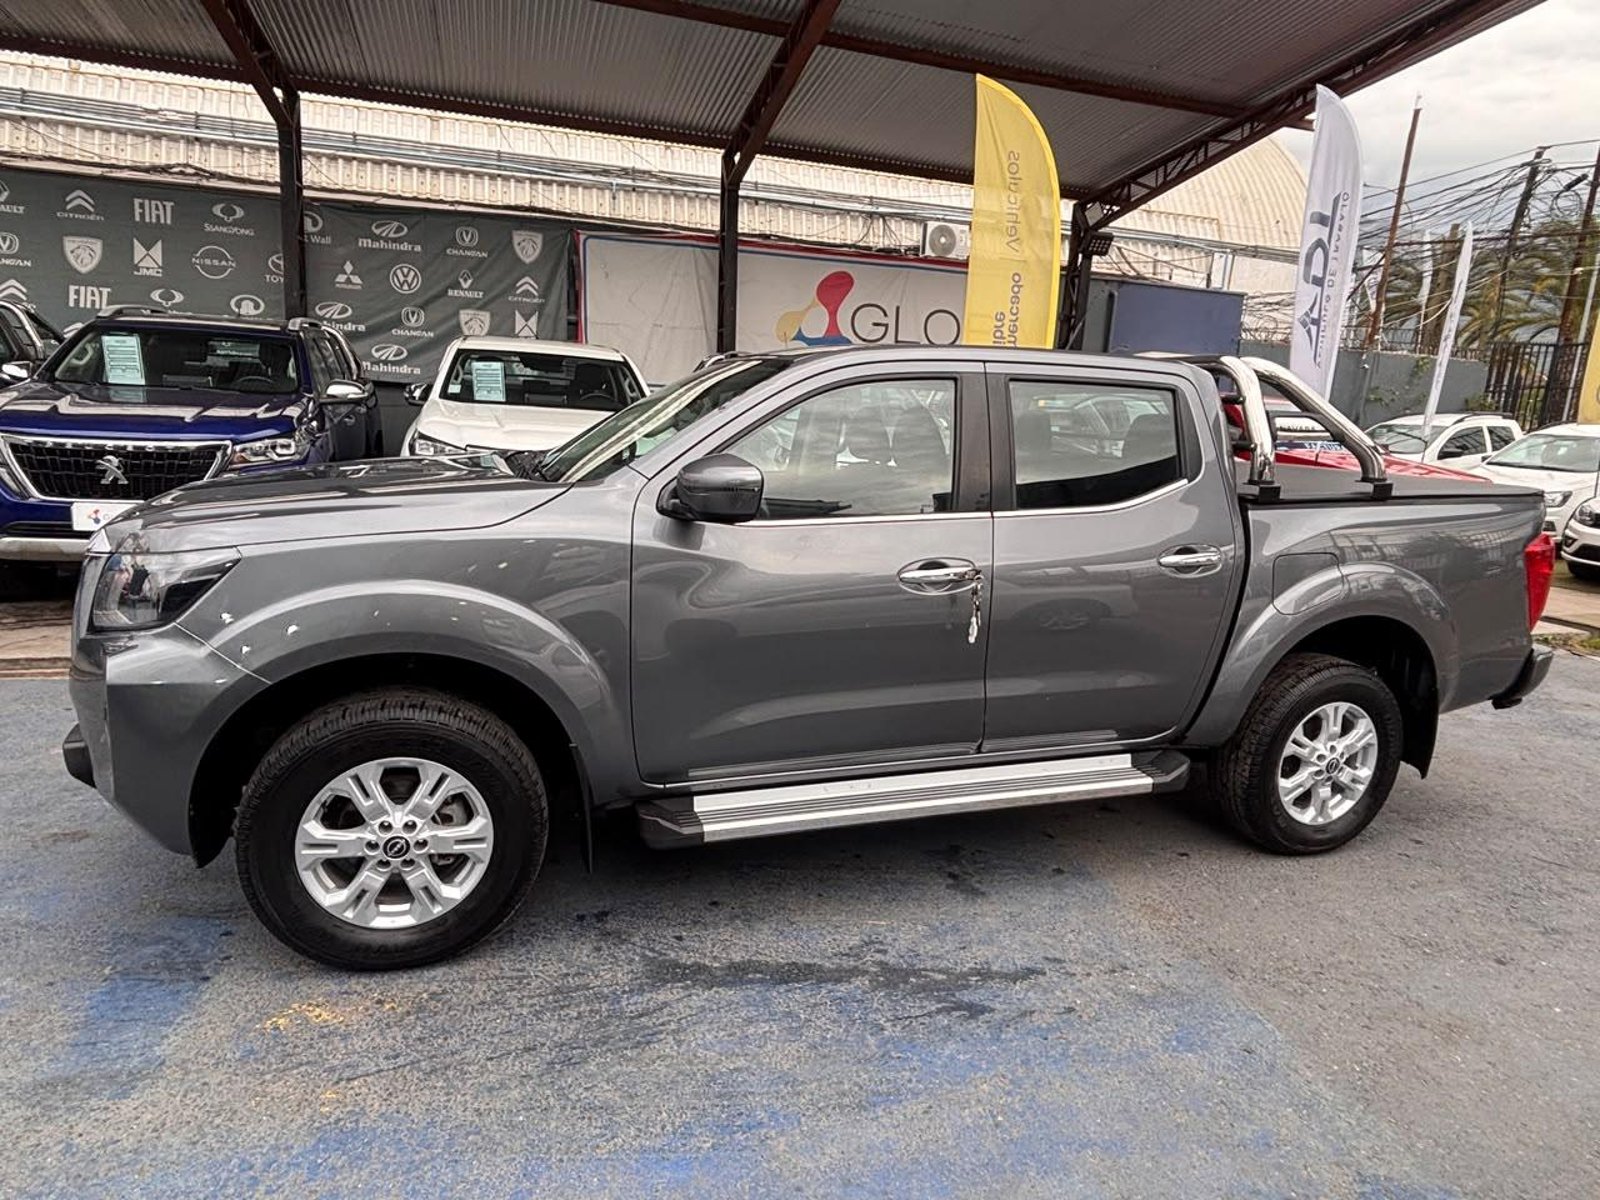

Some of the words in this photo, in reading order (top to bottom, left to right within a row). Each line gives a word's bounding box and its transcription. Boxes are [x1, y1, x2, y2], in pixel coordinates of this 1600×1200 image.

[133, 198, 175, 225] FIAT
[358, 238, 422, 252] Mahindra
[191, 257, 237, 268] NISSAN
[133, 267, 163, 277] JMC
[68, 285, 111, 310] FIAT
[447, 288, 484, 298] RENAULT
